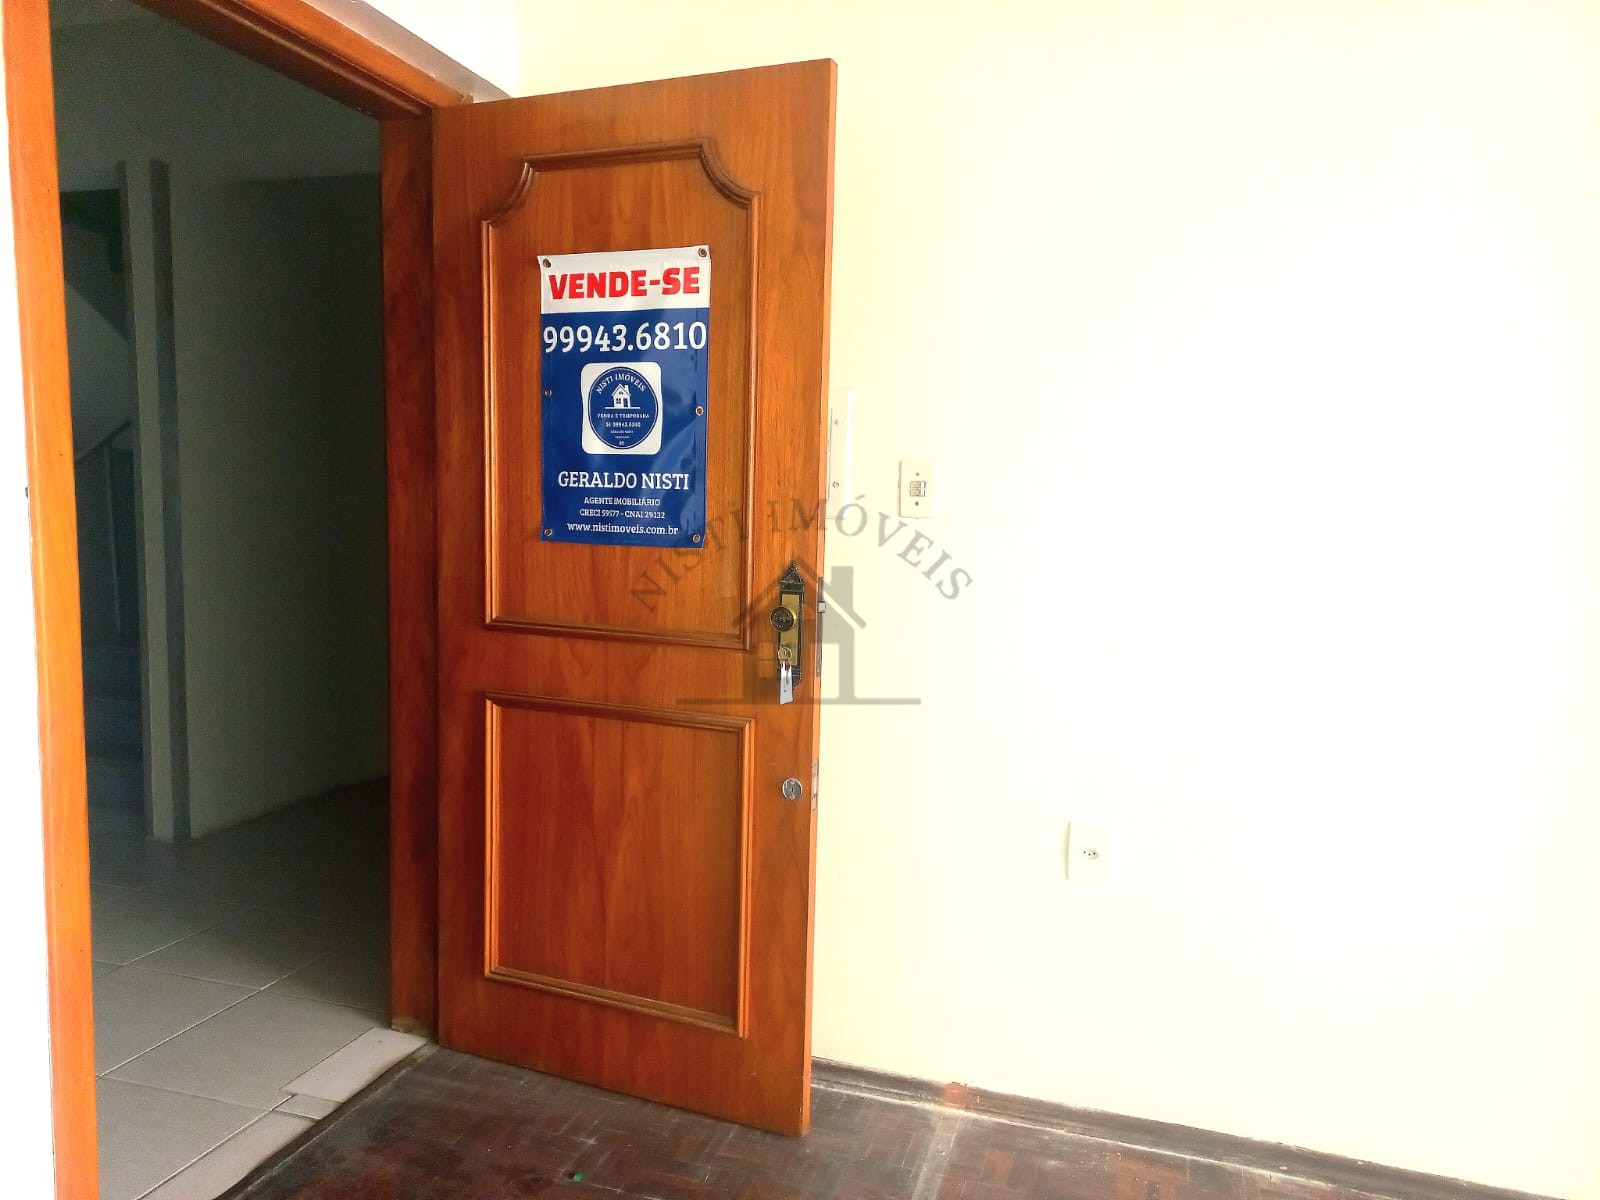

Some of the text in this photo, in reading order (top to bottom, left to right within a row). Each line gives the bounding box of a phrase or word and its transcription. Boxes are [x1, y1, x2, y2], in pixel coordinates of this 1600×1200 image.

[549, 266, 700, 299] VENDE-SE
[543, 321, 707, 353] 99943.6810
[596, 372, 646, 394] NISTI IMÓVEIS
[558, 471, 690, 490] GERALDO NISTI
[584, 496, 661, 506] AGENTE IMOBILIÁRIO
[579, 509, 601, 517] CRECI
[624, 510, 643, 518] CNAI
[566, 522, 679, 536] www.nistimoveis.com.br
